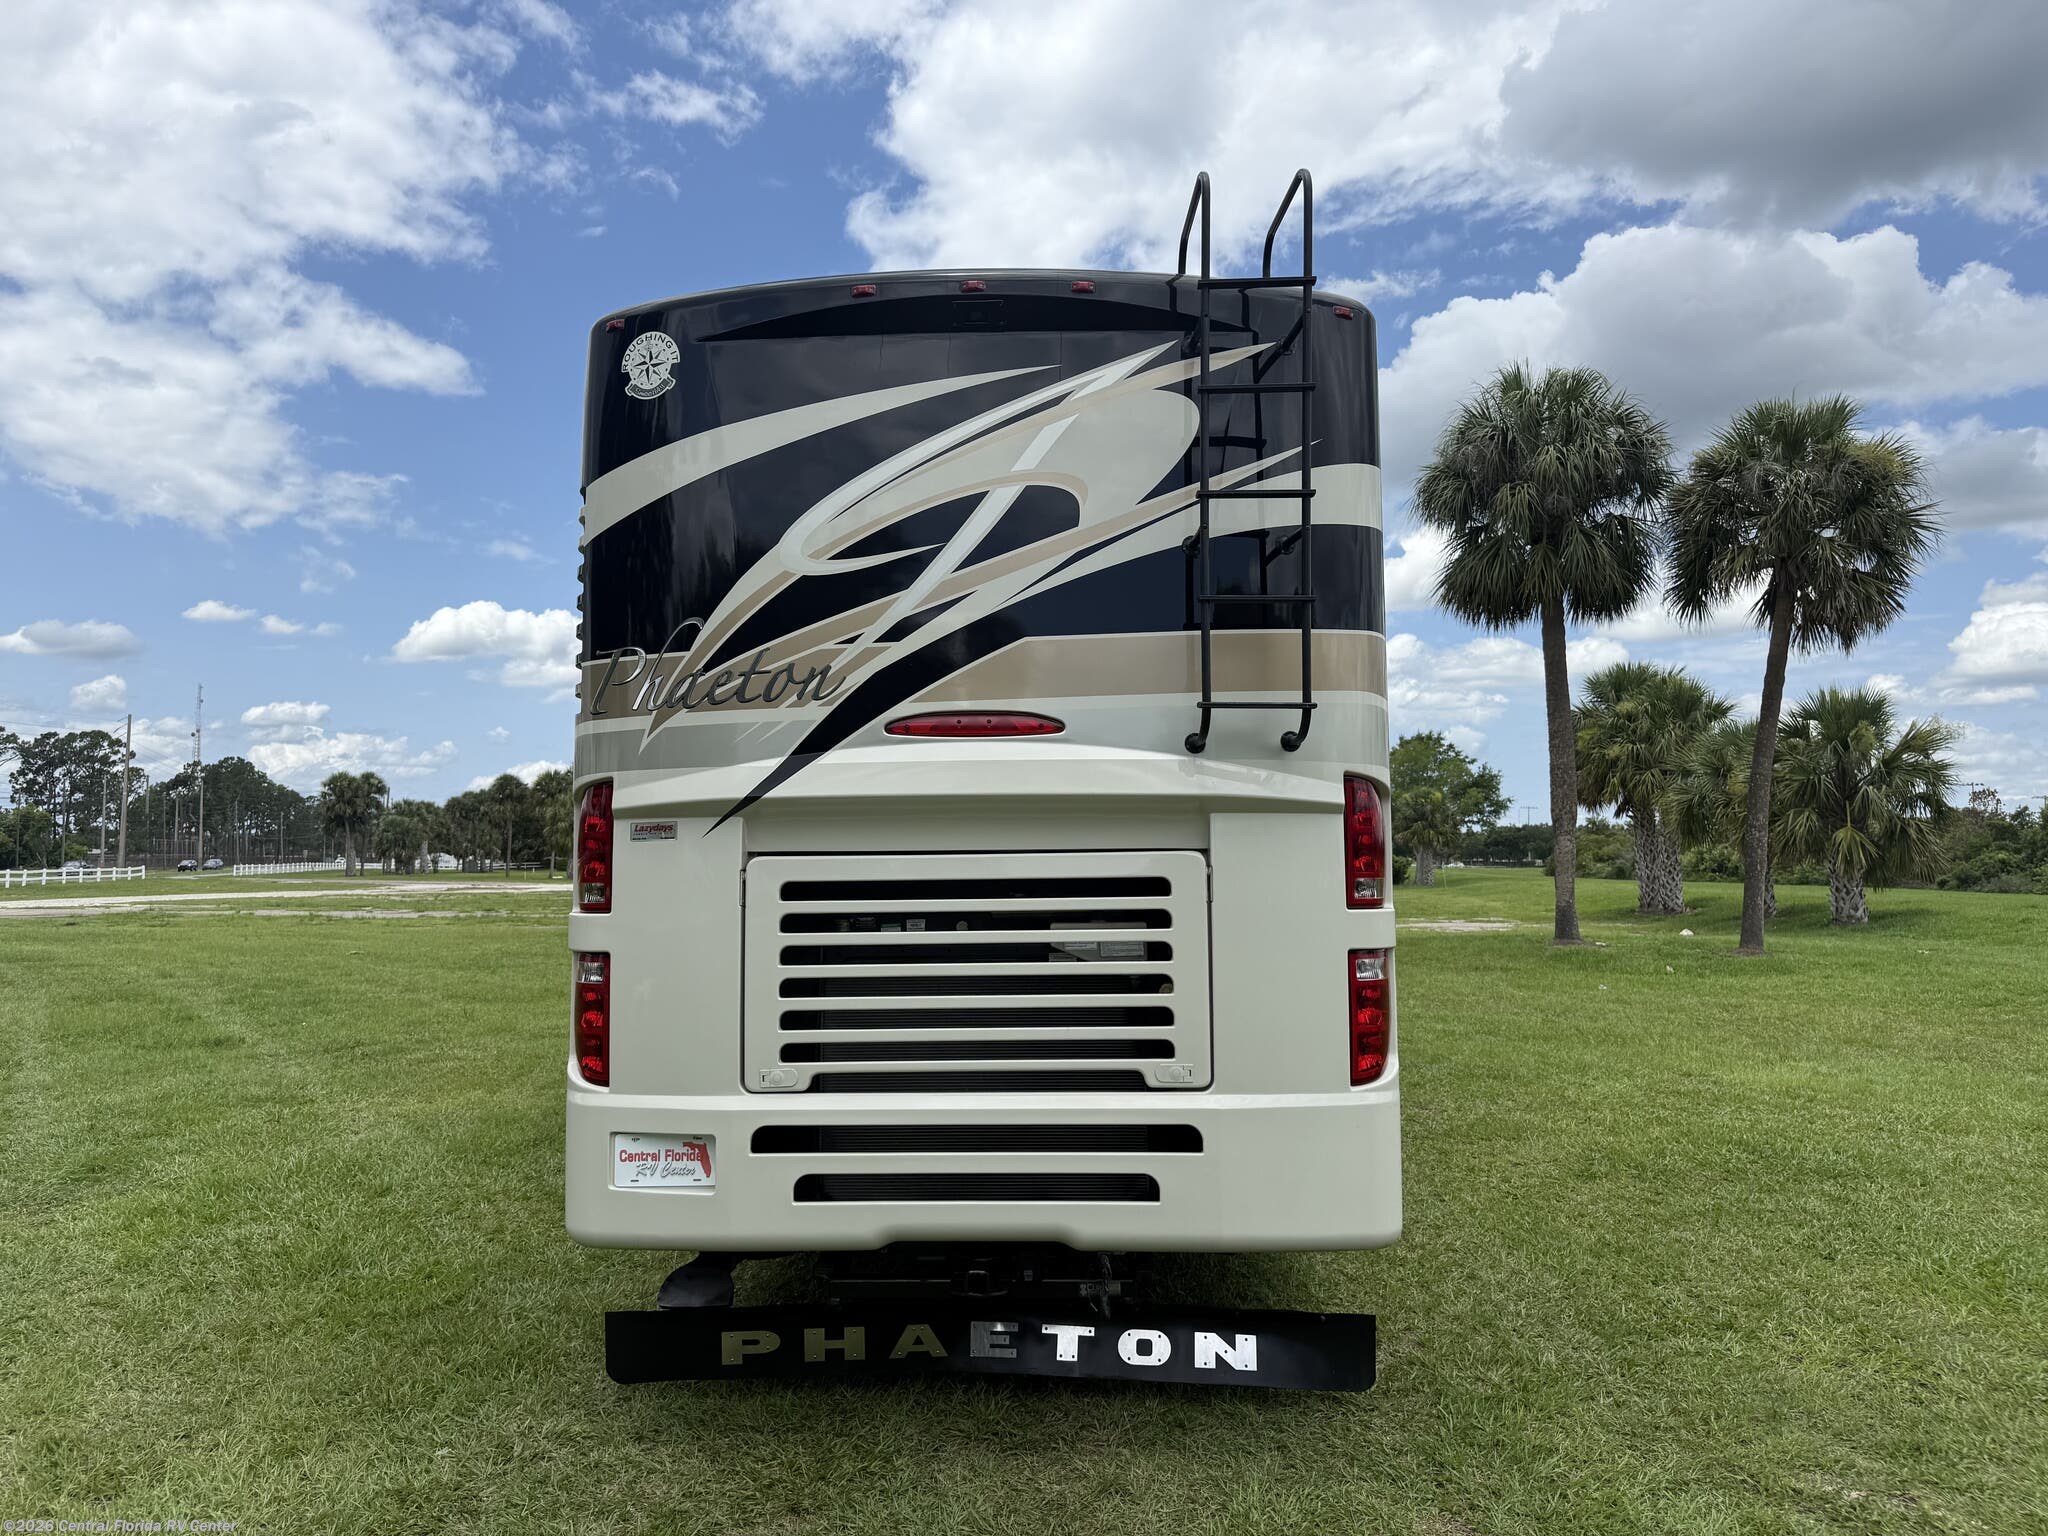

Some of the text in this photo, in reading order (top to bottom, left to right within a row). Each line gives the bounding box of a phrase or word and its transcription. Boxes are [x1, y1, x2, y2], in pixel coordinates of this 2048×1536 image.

[623, 333, 679, 371] ROUGHING IT
[590, 617, 846, 715] Phaeton
[619, 1149, 702, 1162] Central Florida
[636, 1161, 697, 1178] RV Center
[721, 1321, 1258, 1371] PHAETON
